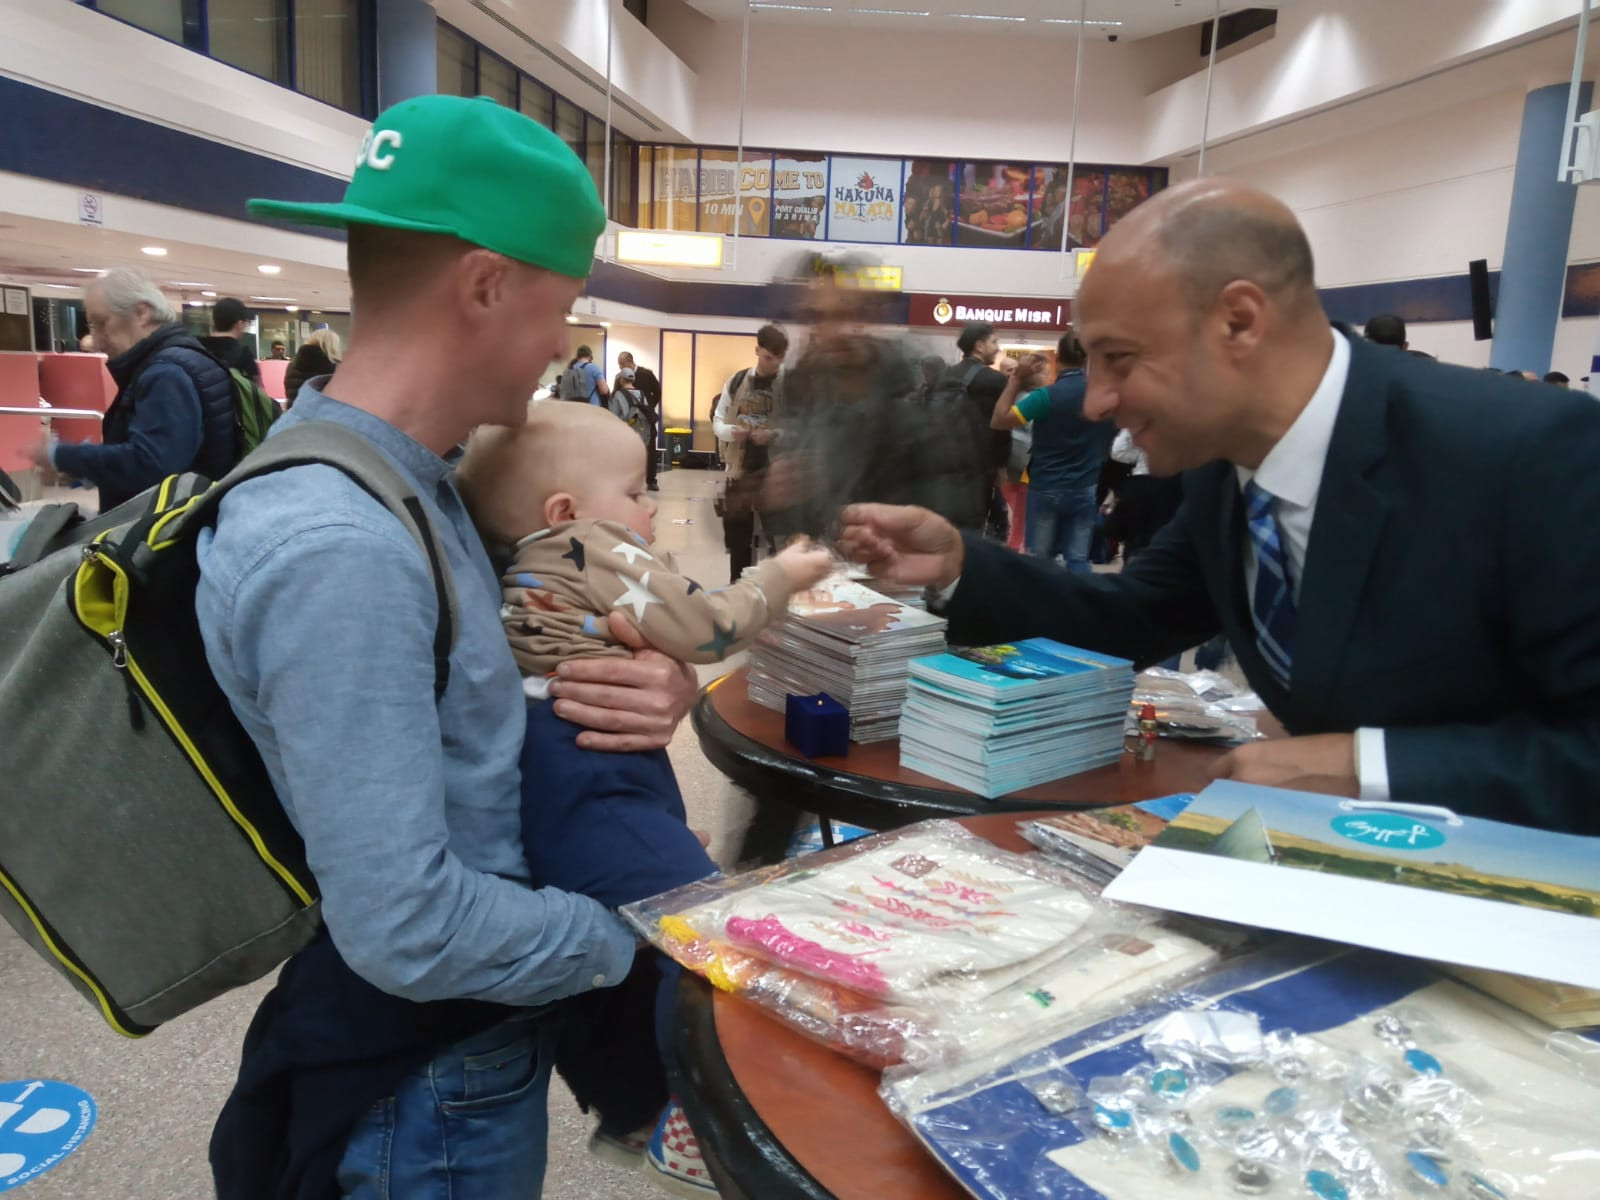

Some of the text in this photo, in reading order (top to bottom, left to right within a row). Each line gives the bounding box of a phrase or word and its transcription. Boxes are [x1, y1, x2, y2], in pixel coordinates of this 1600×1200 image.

[657, 167, 825, 198] HABIBI COME TO
[835, 186, 894, 202] HAKUNA
[704, 203, 743, 216] 10 MIN
[774, 213, 818, 221] MARINA
[775, 205, 818, 214] PORT GHALIB
[834, 201, 894, 217] MATATA
[955, 306, 1052, 323] BANQUE MISR
[7, 1152, 65, 1184] SOCIAL
